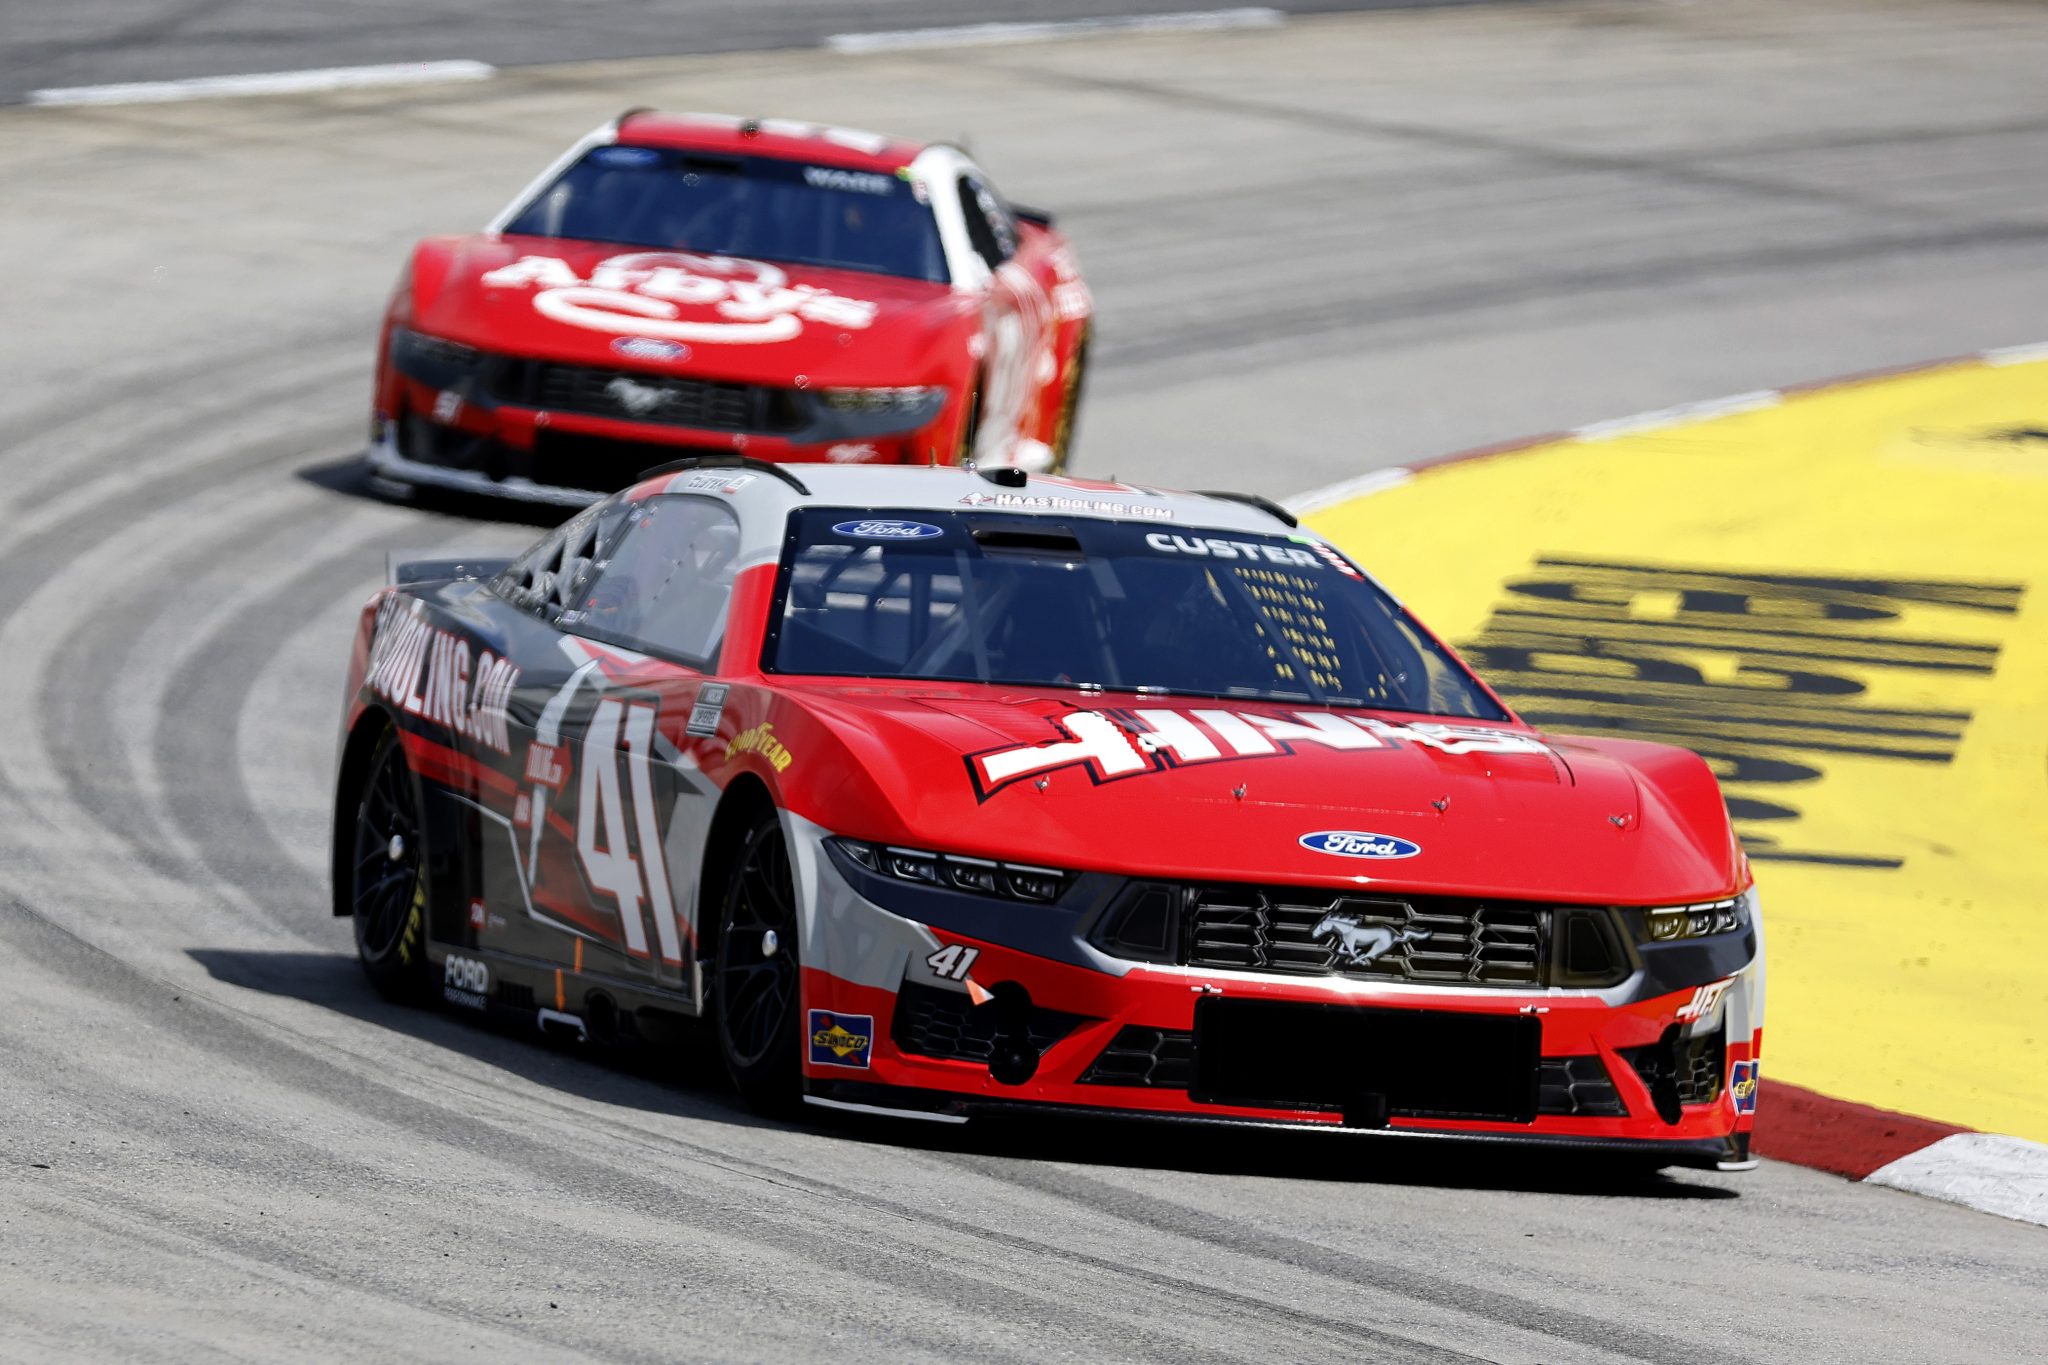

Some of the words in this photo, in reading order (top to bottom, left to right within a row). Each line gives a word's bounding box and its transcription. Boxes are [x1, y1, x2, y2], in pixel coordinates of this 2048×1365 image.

[850, 520, 925, 538] Ford
[1145, 533, 1325, 570] CUSTER
[576, 695, 684, 967] 41
[1320, 831, 1402, 857] Ford
[445, 953, 490, 994] FORD
[927, 944, 981, 983] 41
[814, 1031, 869, 1052] SUNOCO
